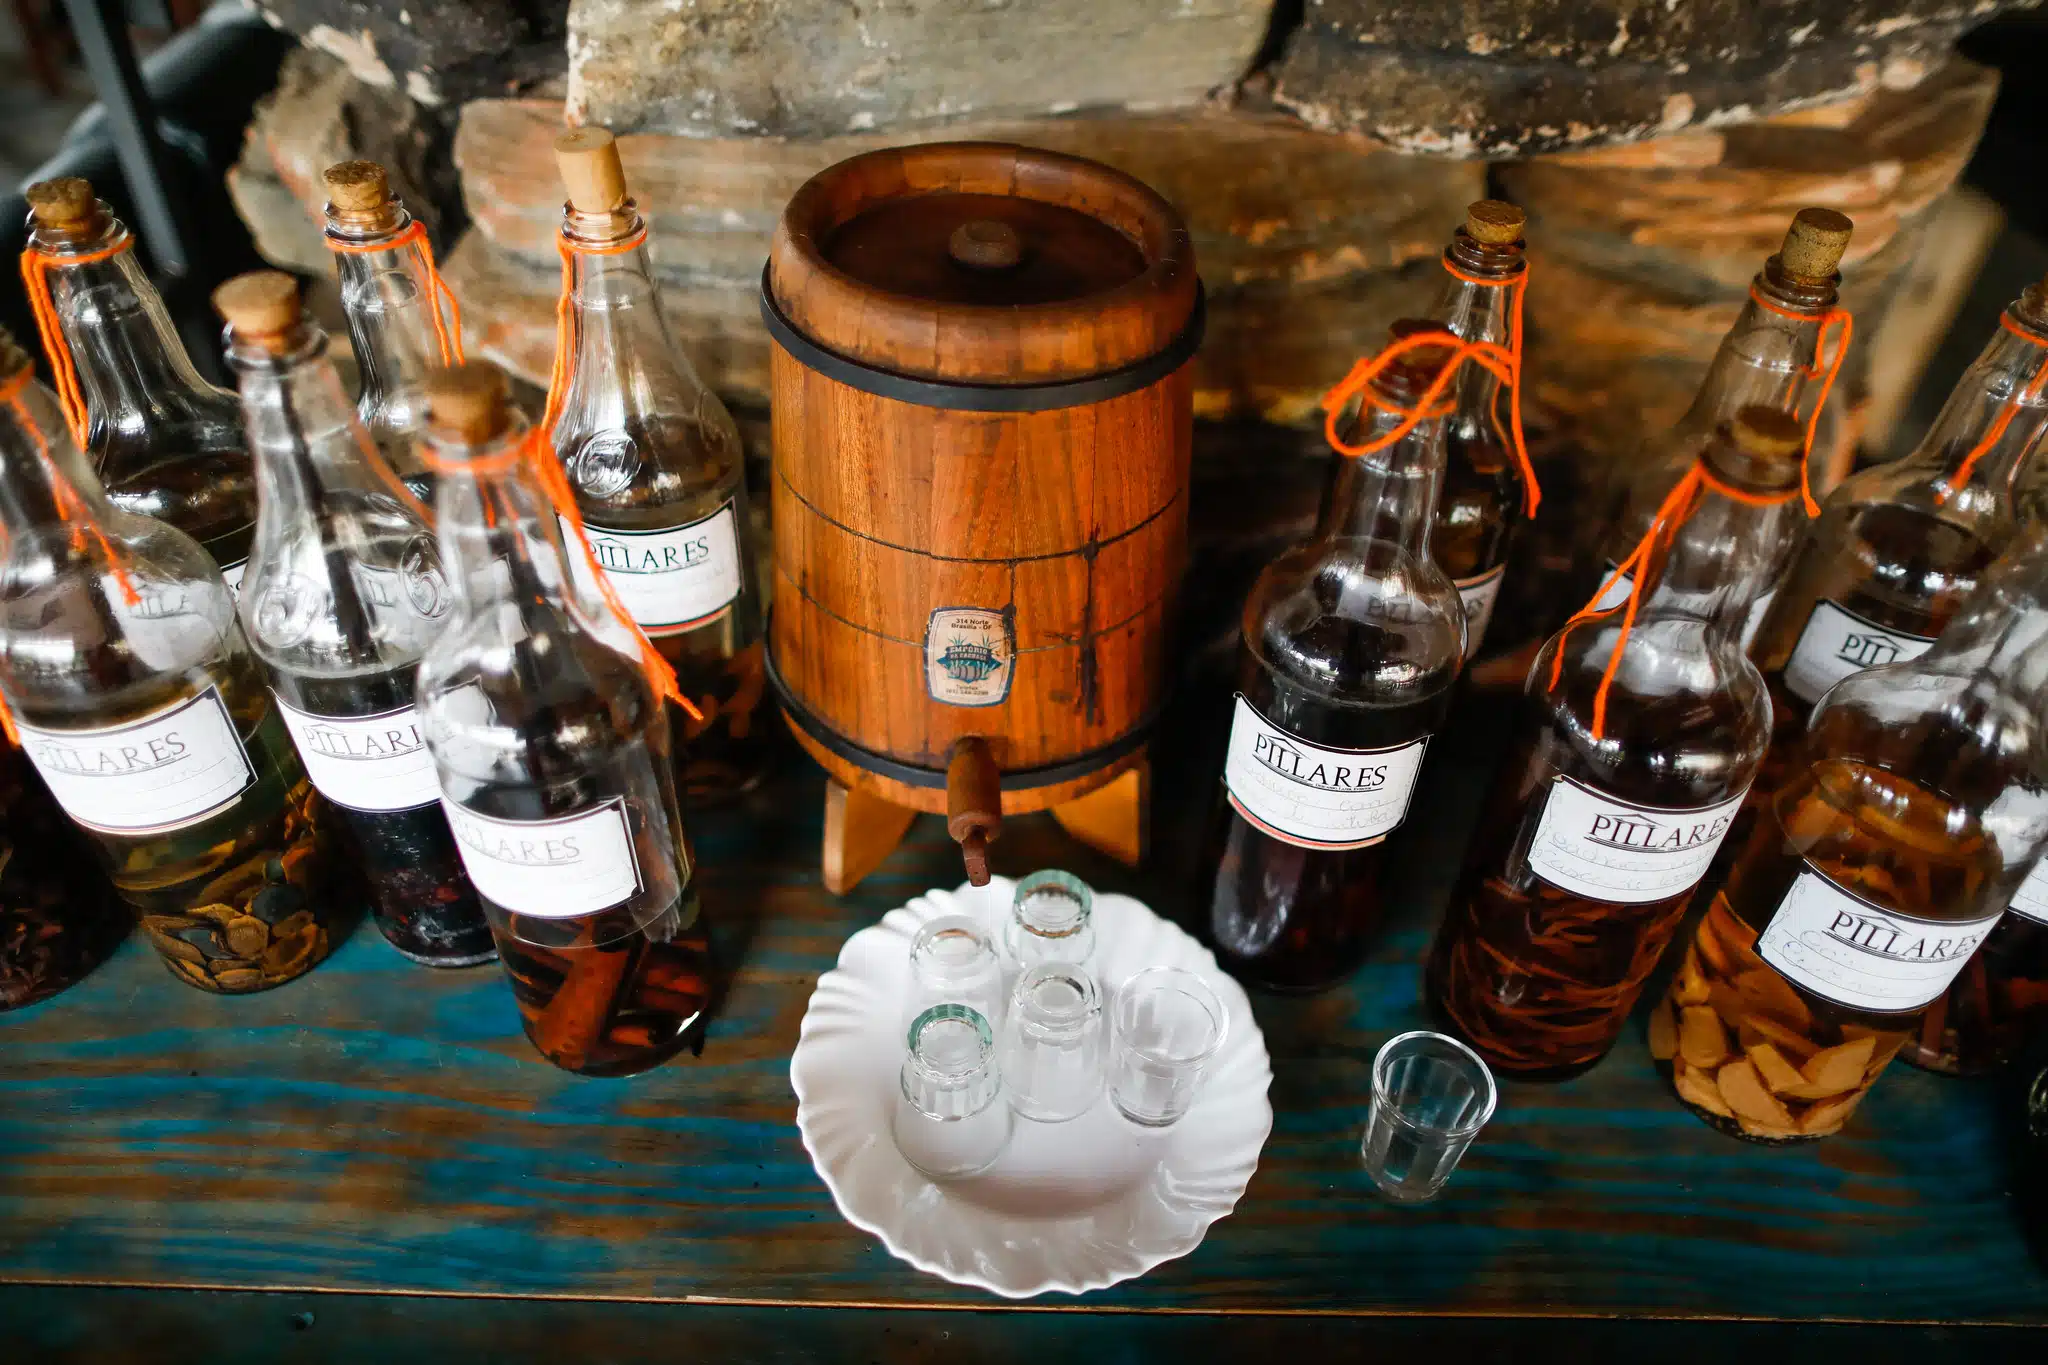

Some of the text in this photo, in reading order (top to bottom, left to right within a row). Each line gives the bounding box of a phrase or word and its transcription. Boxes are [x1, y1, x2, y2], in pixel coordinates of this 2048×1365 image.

[1254, 732, 1388, 788] PILLARES
[1588, 809, 1734, 848] PILLARES
[1829, 909, 1985, 958] PILLARES
